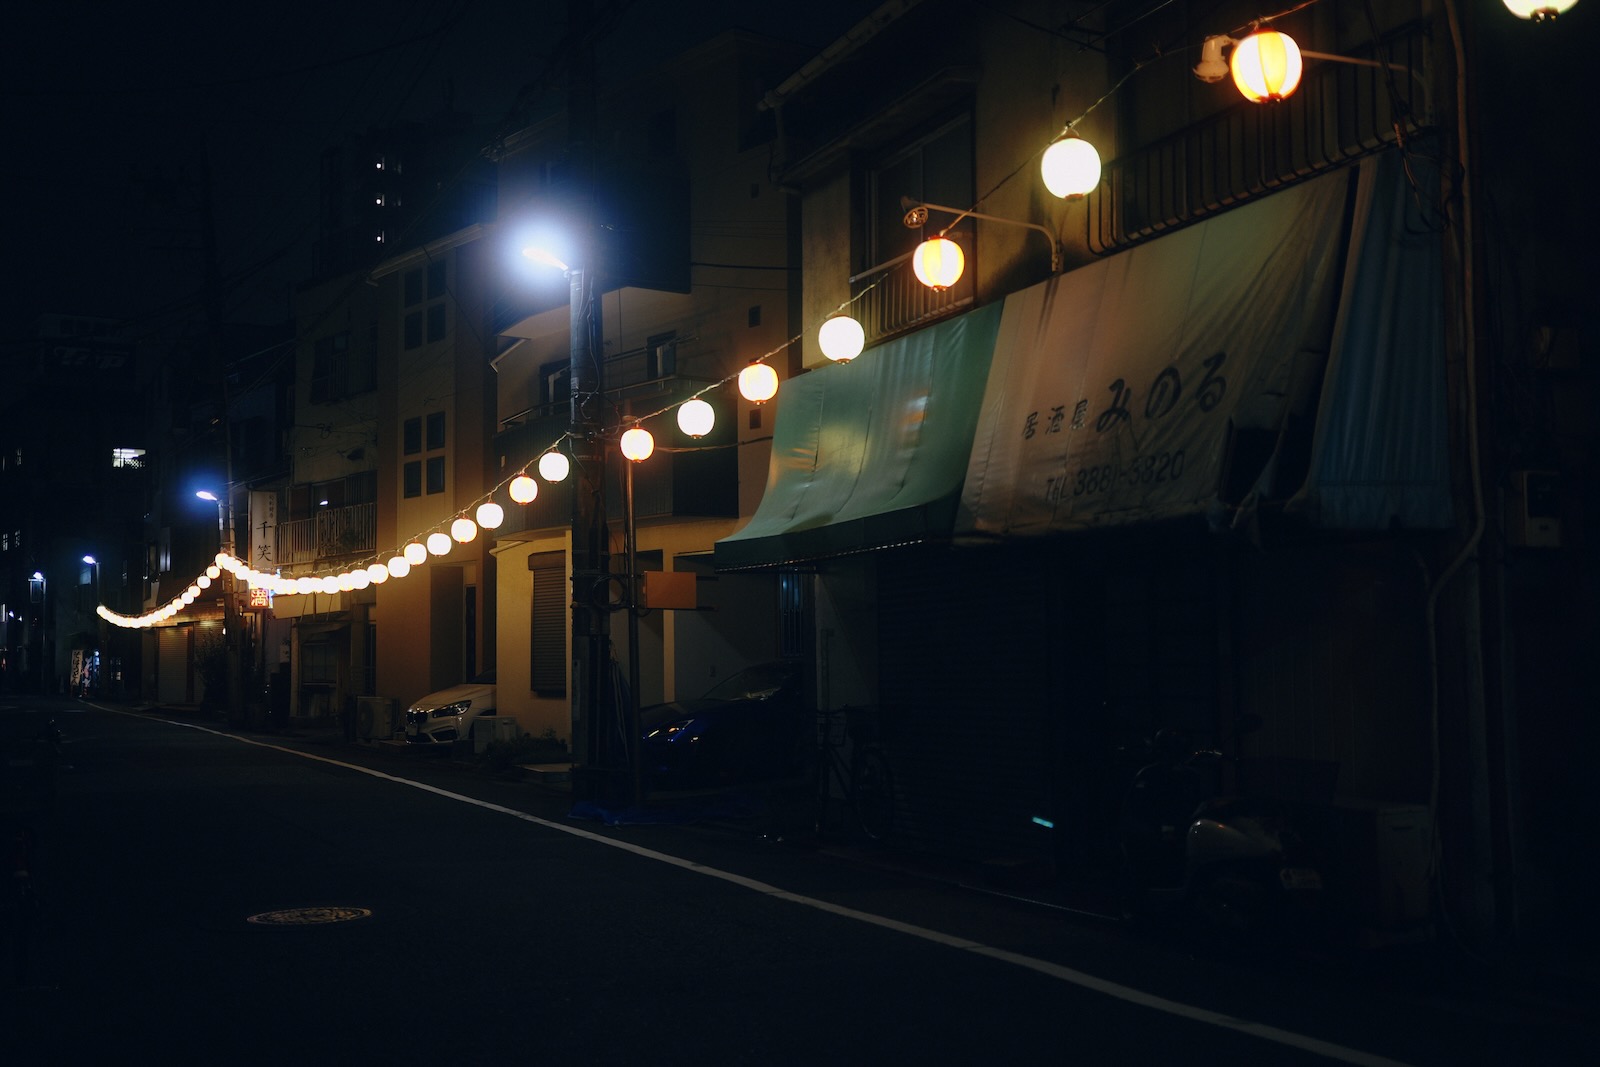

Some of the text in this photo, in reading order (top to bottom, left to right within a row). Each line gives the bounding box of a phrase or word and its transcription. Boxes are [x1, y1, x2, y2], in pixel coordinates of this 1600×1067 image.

[1022, 351, 1227, 439] 居酒屋 みのる
[1074, 450, 1185, 495] 3881-5820
[256, 521, 273, 562] 千笑
